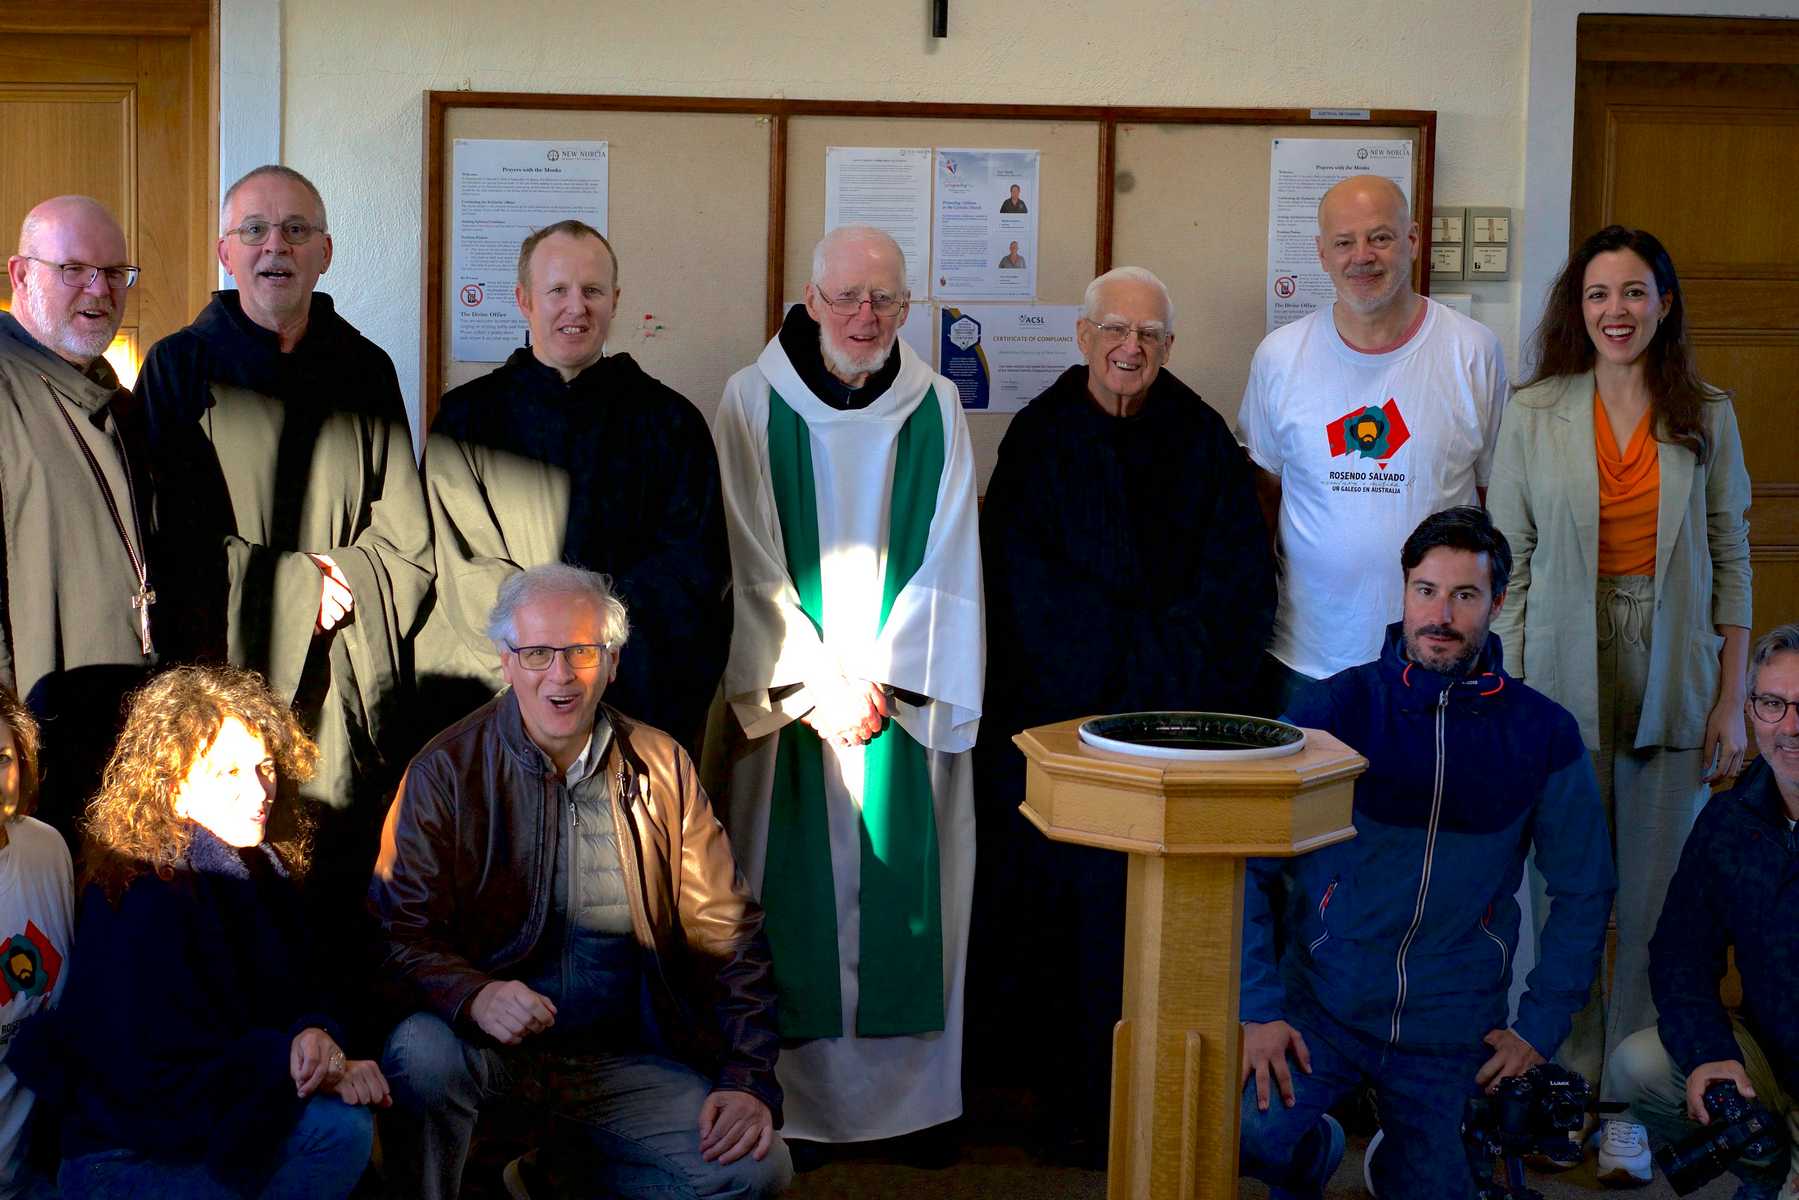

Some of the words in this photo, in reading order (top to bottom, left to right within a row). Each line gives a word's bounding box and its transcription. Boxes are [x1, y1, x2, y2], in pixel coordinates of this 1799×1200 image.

[561, 150, 579, 158] NEW
[580, 150, 606, 158] NORCIA
[1025, 316, 1045, 324] ACSL
[1329, 471, 1367, 480] ROSENDO
[1368, 472, 1405, 482] SALVADO
